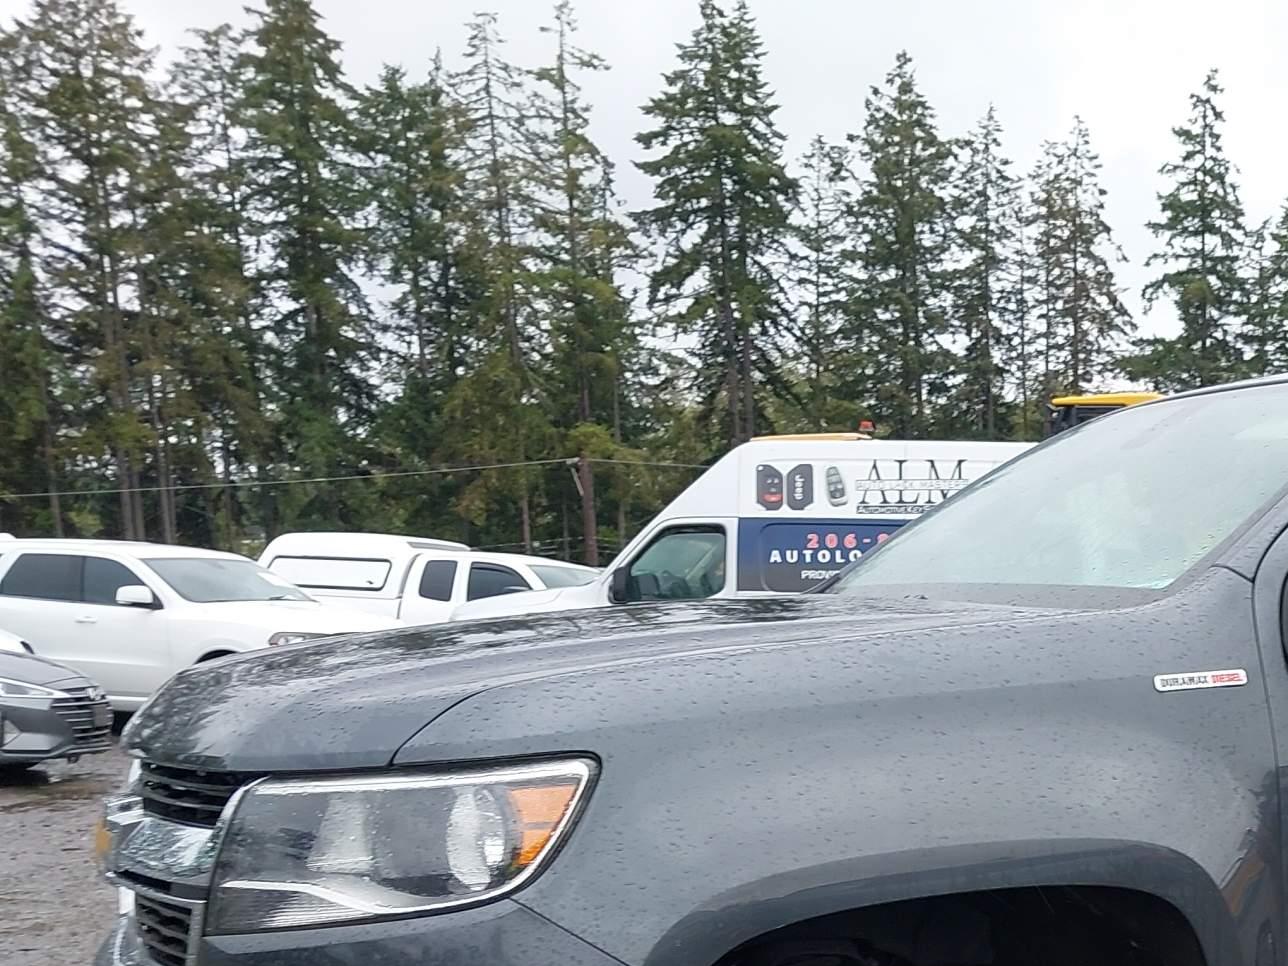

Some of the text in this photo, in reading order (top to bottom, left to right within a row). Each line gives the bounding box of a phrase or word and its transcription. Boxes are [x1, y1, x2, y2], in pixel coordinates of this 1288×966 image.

[793, 474, 805, 500] Jeep
[858, 459, 968, 504] ALM
[769, 549, 863, 563] AUTOLO
[1159, 672, 1243, 688] DURAMAX DIESEL
